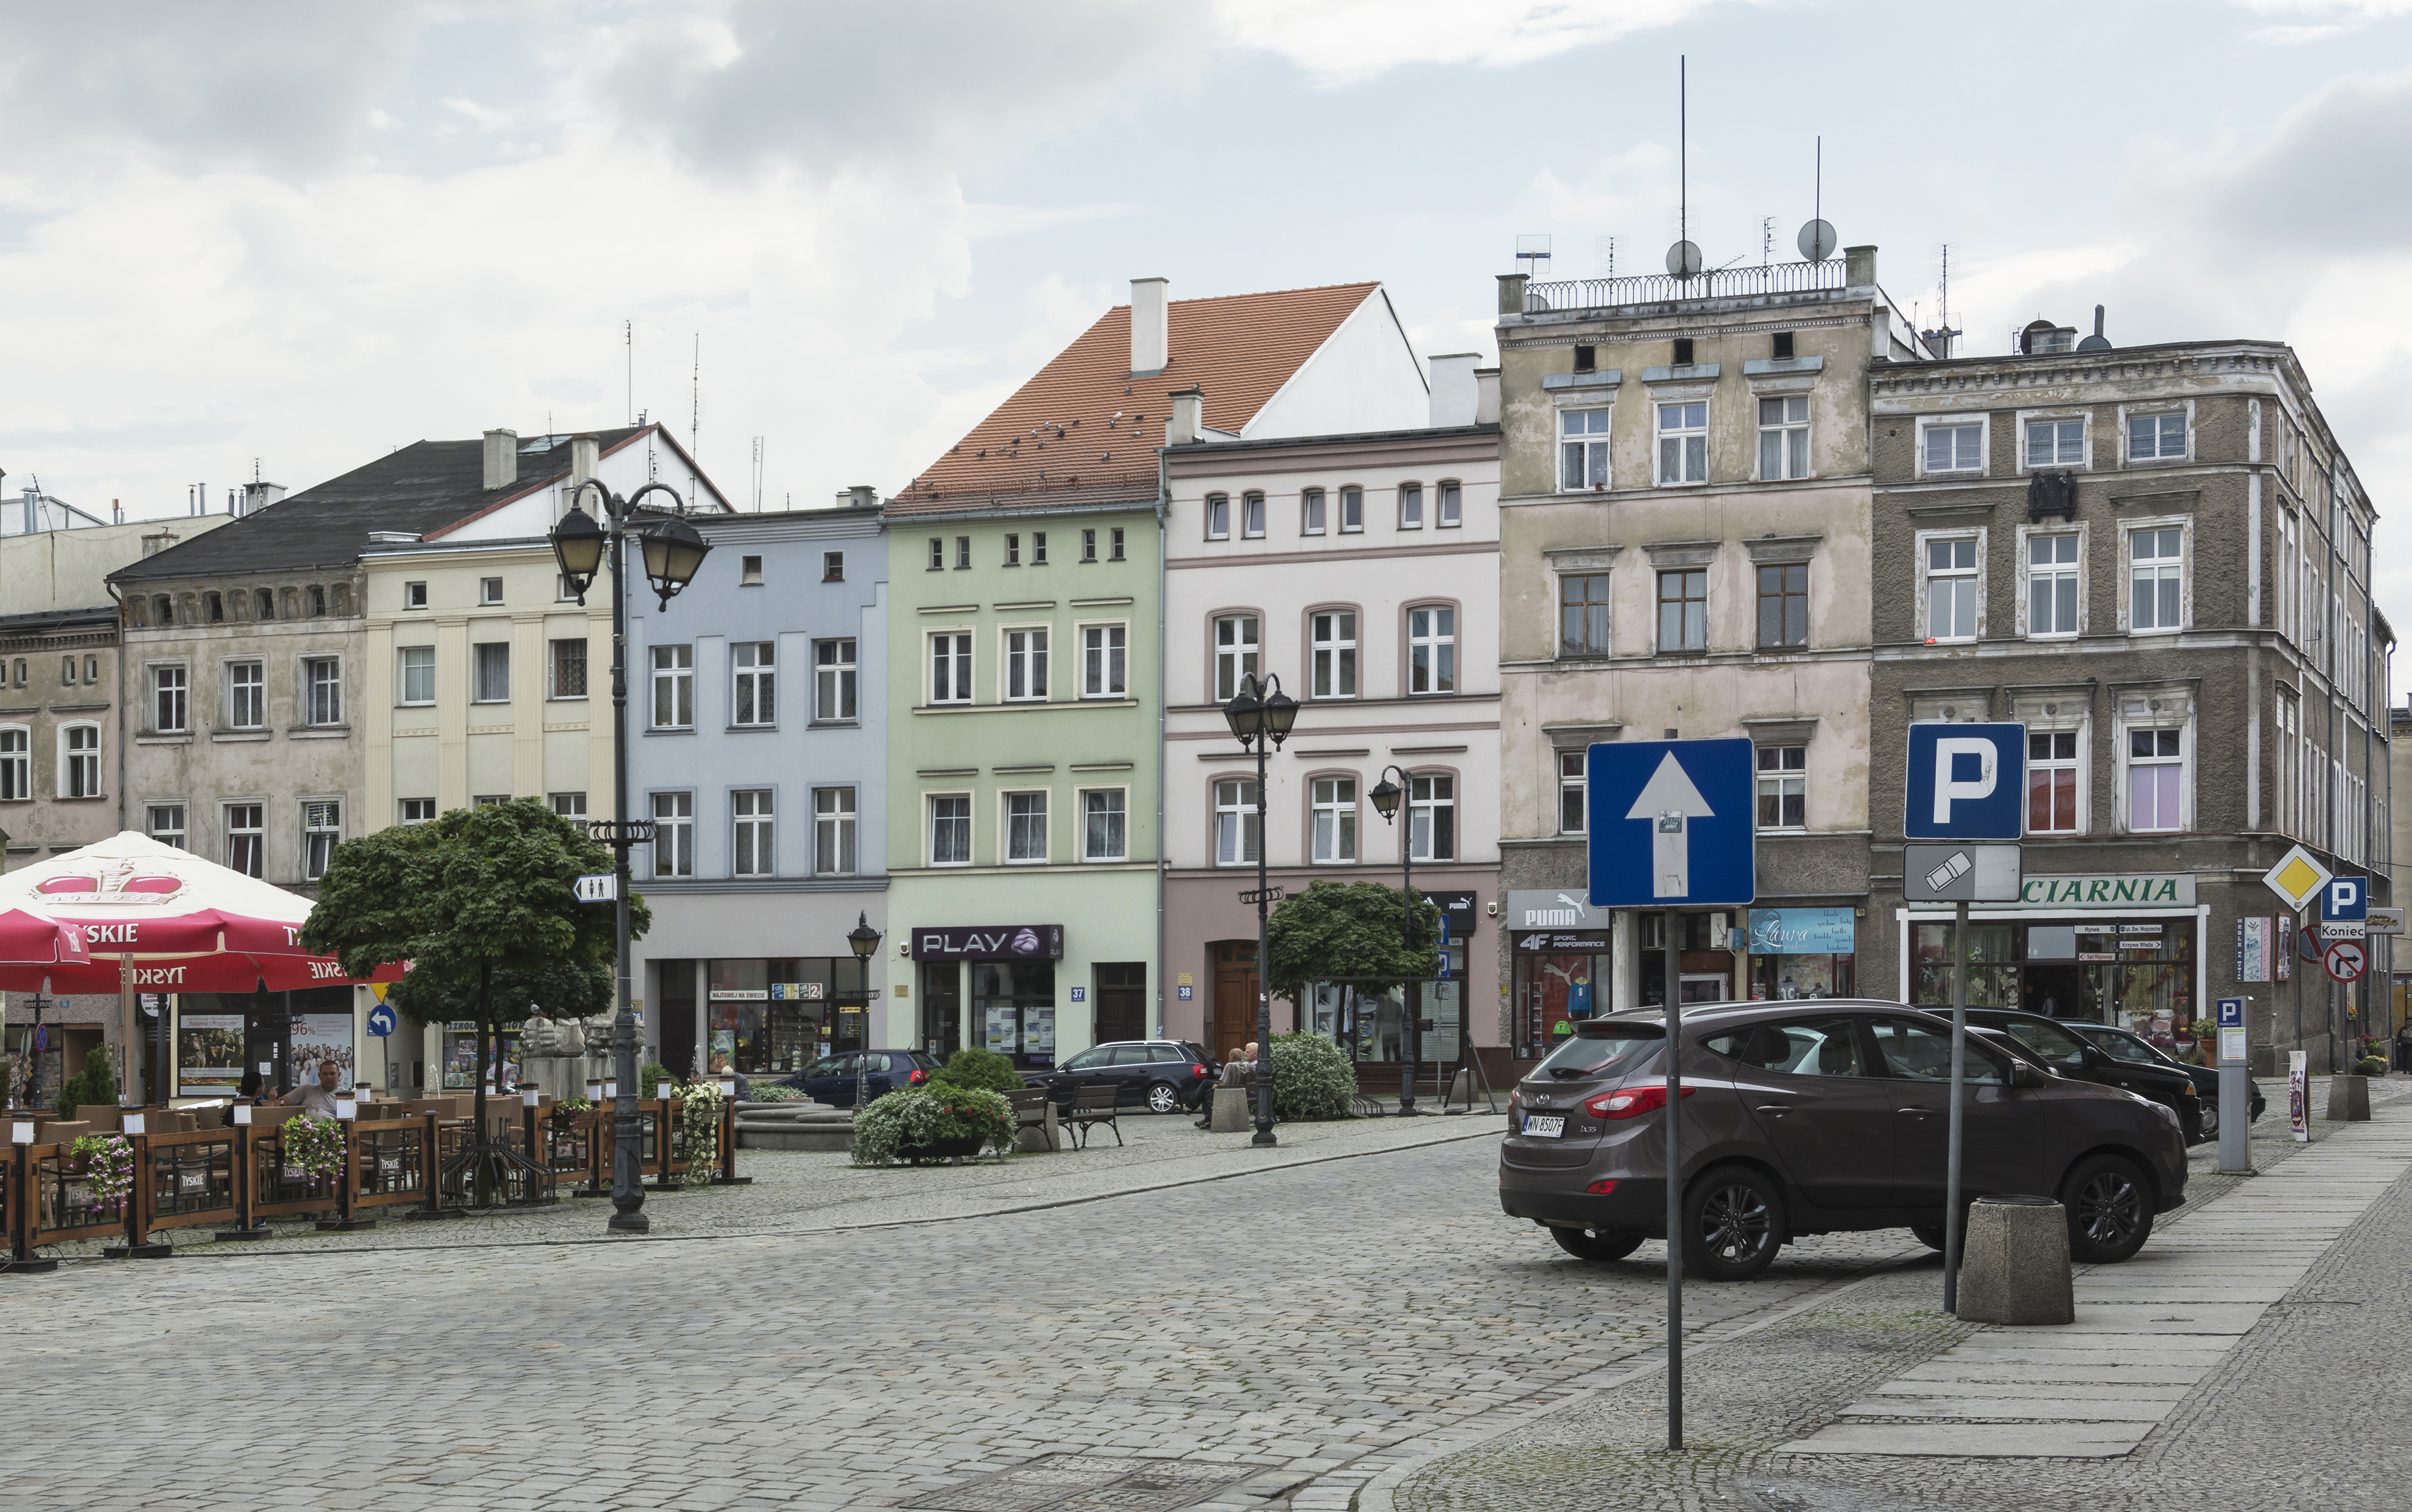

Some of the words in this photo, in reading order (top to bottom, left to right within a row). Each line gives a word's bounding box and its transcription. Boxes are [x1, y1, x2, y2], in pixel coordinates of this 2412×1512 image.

[1934, 737, 1998, 823] P
[2022, 878, 2178, 904] CIARNIA
[2332, 882, 2357, 915] P
[1526, 909, 1576, 926] PUMA
[80, 923, 139, 943] YSKIE
[1750, 920, 1808, 948] Laura
[2322, 926, 2364, 936] Koniec
[923, 933, 1008, 953] PLAY
[1520, 934, 1550, 950] 4F
[811, 985, 818, 998] 2
[1073, 989, 1083, 998] 37
[1179, 987, 1190, 997] 38
[2222, 1002, 2236, 1021] P
[292, 1022, 316, 1036] 96%
[1527, 1117, 1539, 1131] WN
[1539, 1117, 1564, 1133] 8507F
[380, 1157, 400, 1170] TYSKIE
[181, 1173, 204, 1187] TYSKIE
